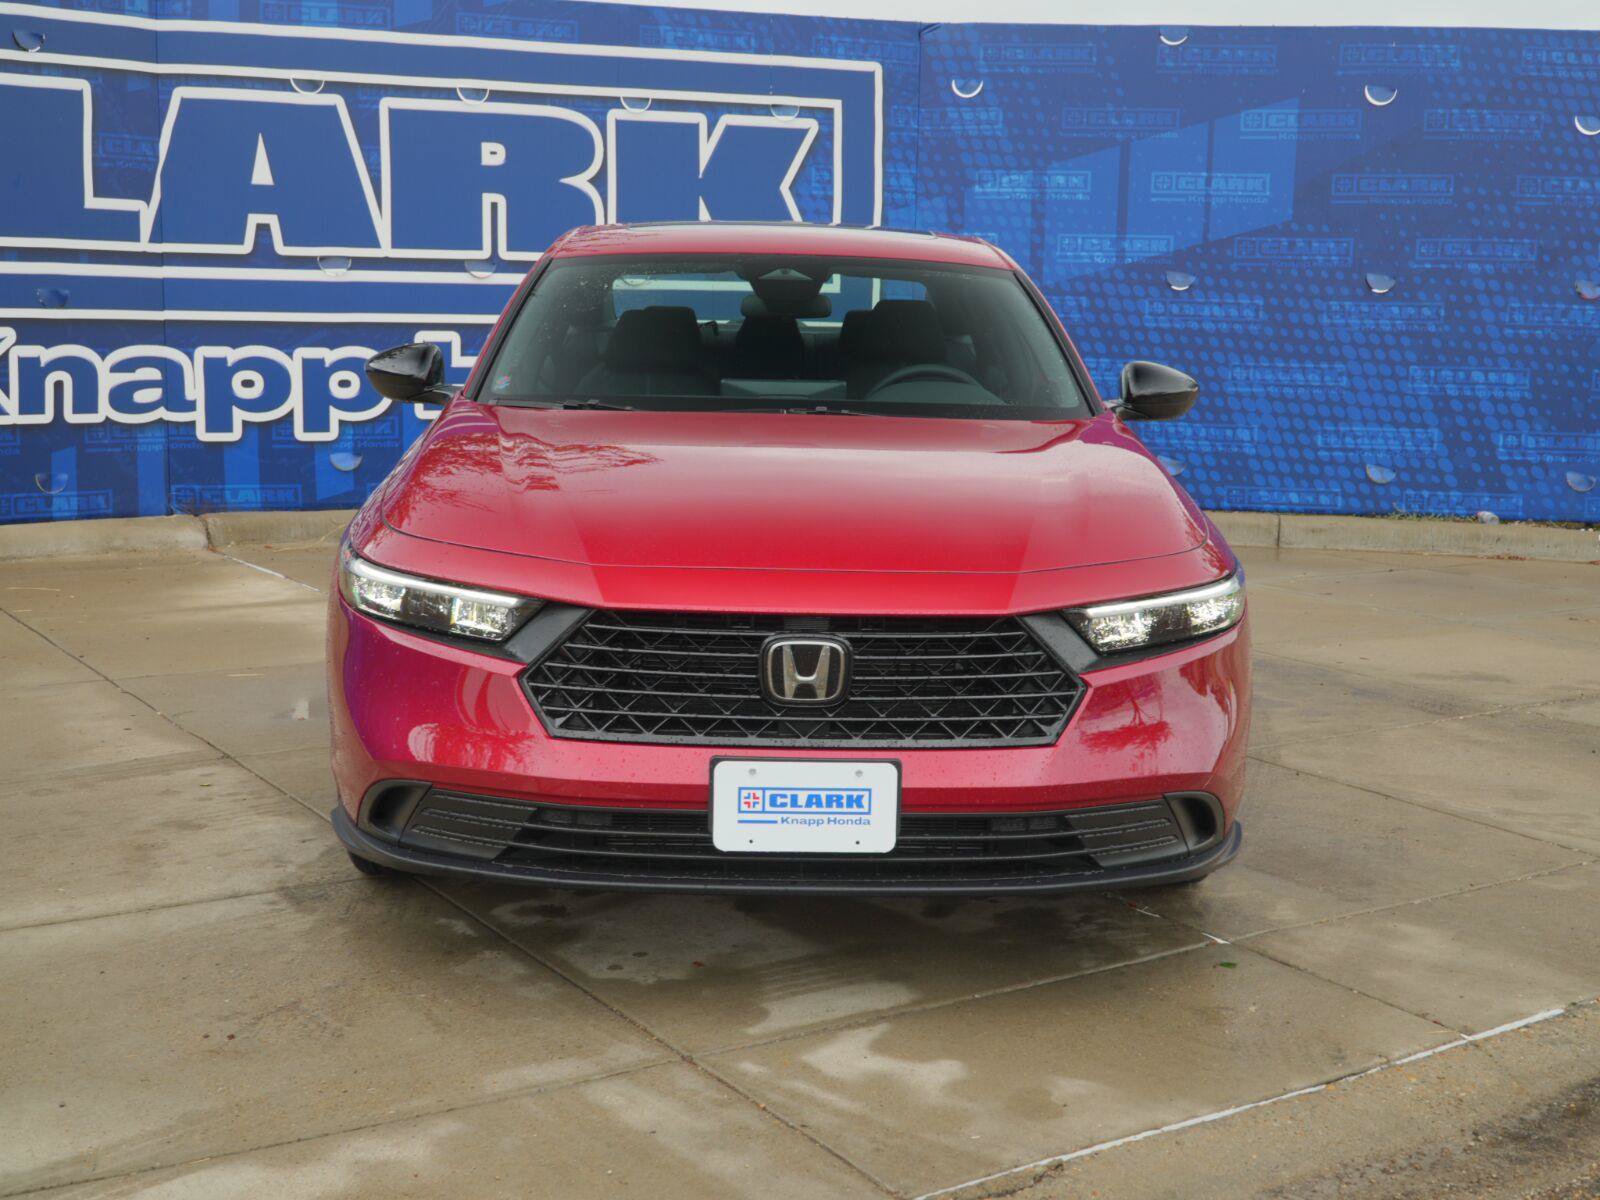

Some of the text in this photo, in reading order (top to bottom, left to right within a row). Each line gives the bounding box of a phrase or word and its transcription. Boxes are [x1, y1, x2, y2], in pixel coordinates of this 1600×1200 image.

[0, 327, 395, 442] napp
[769, 793, 866, 809] CLARK
[780, 816, 871, 827] Knapp Honda
